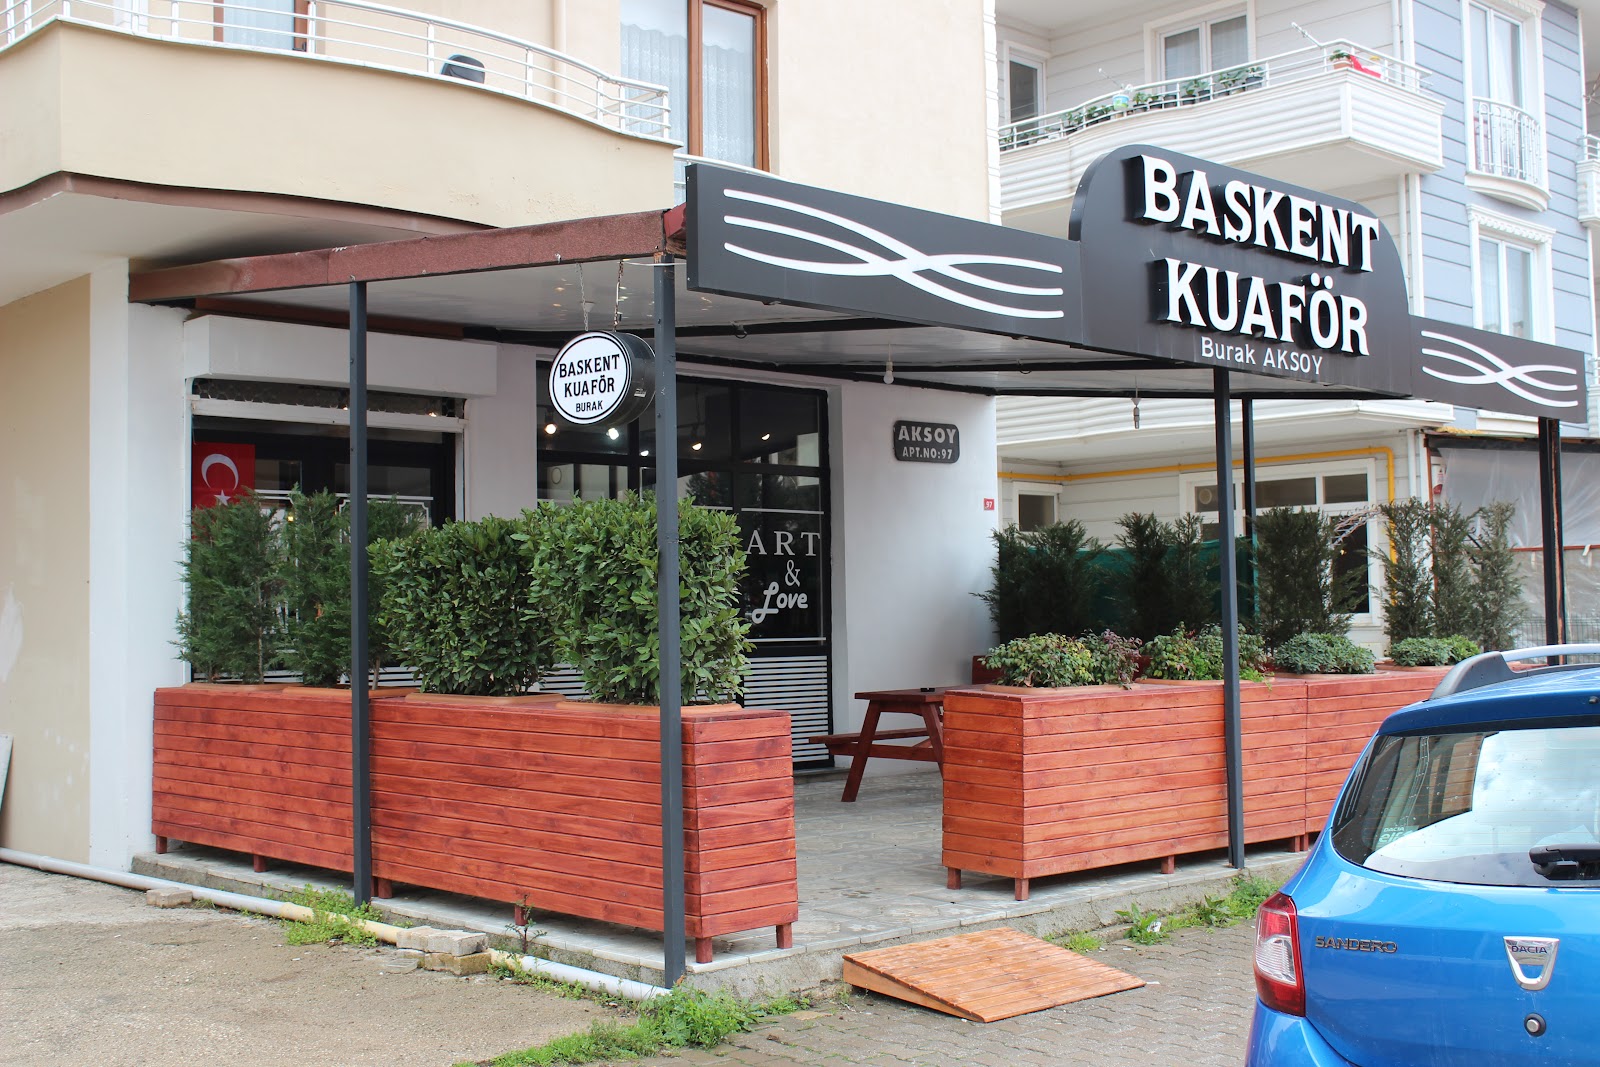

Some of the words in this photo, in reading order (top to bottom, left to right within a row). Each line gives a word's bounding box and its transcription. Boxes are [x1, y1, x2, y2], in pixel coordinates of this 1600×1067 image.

[1165, 258, 1369, 356] KUAFÖR
[1201, 336, 1256, 365] Burak
[1263, 347, 1323, 375] AKSOY
[564, 375, 615, 398] KUAFÖR
[575, 400, 604, 413] BURAK
[898, 425, 957, 444] AKSOY
[902, 446, 953, 460] APT.NO:97
[745, 529, 821, 557] ART
[784, 559, 801, 587] &
[751, 581, 809, 624] Love
[1314, 935, 1398, 954] SANDERO
[1511, 945, 1548, 954] DACIA
